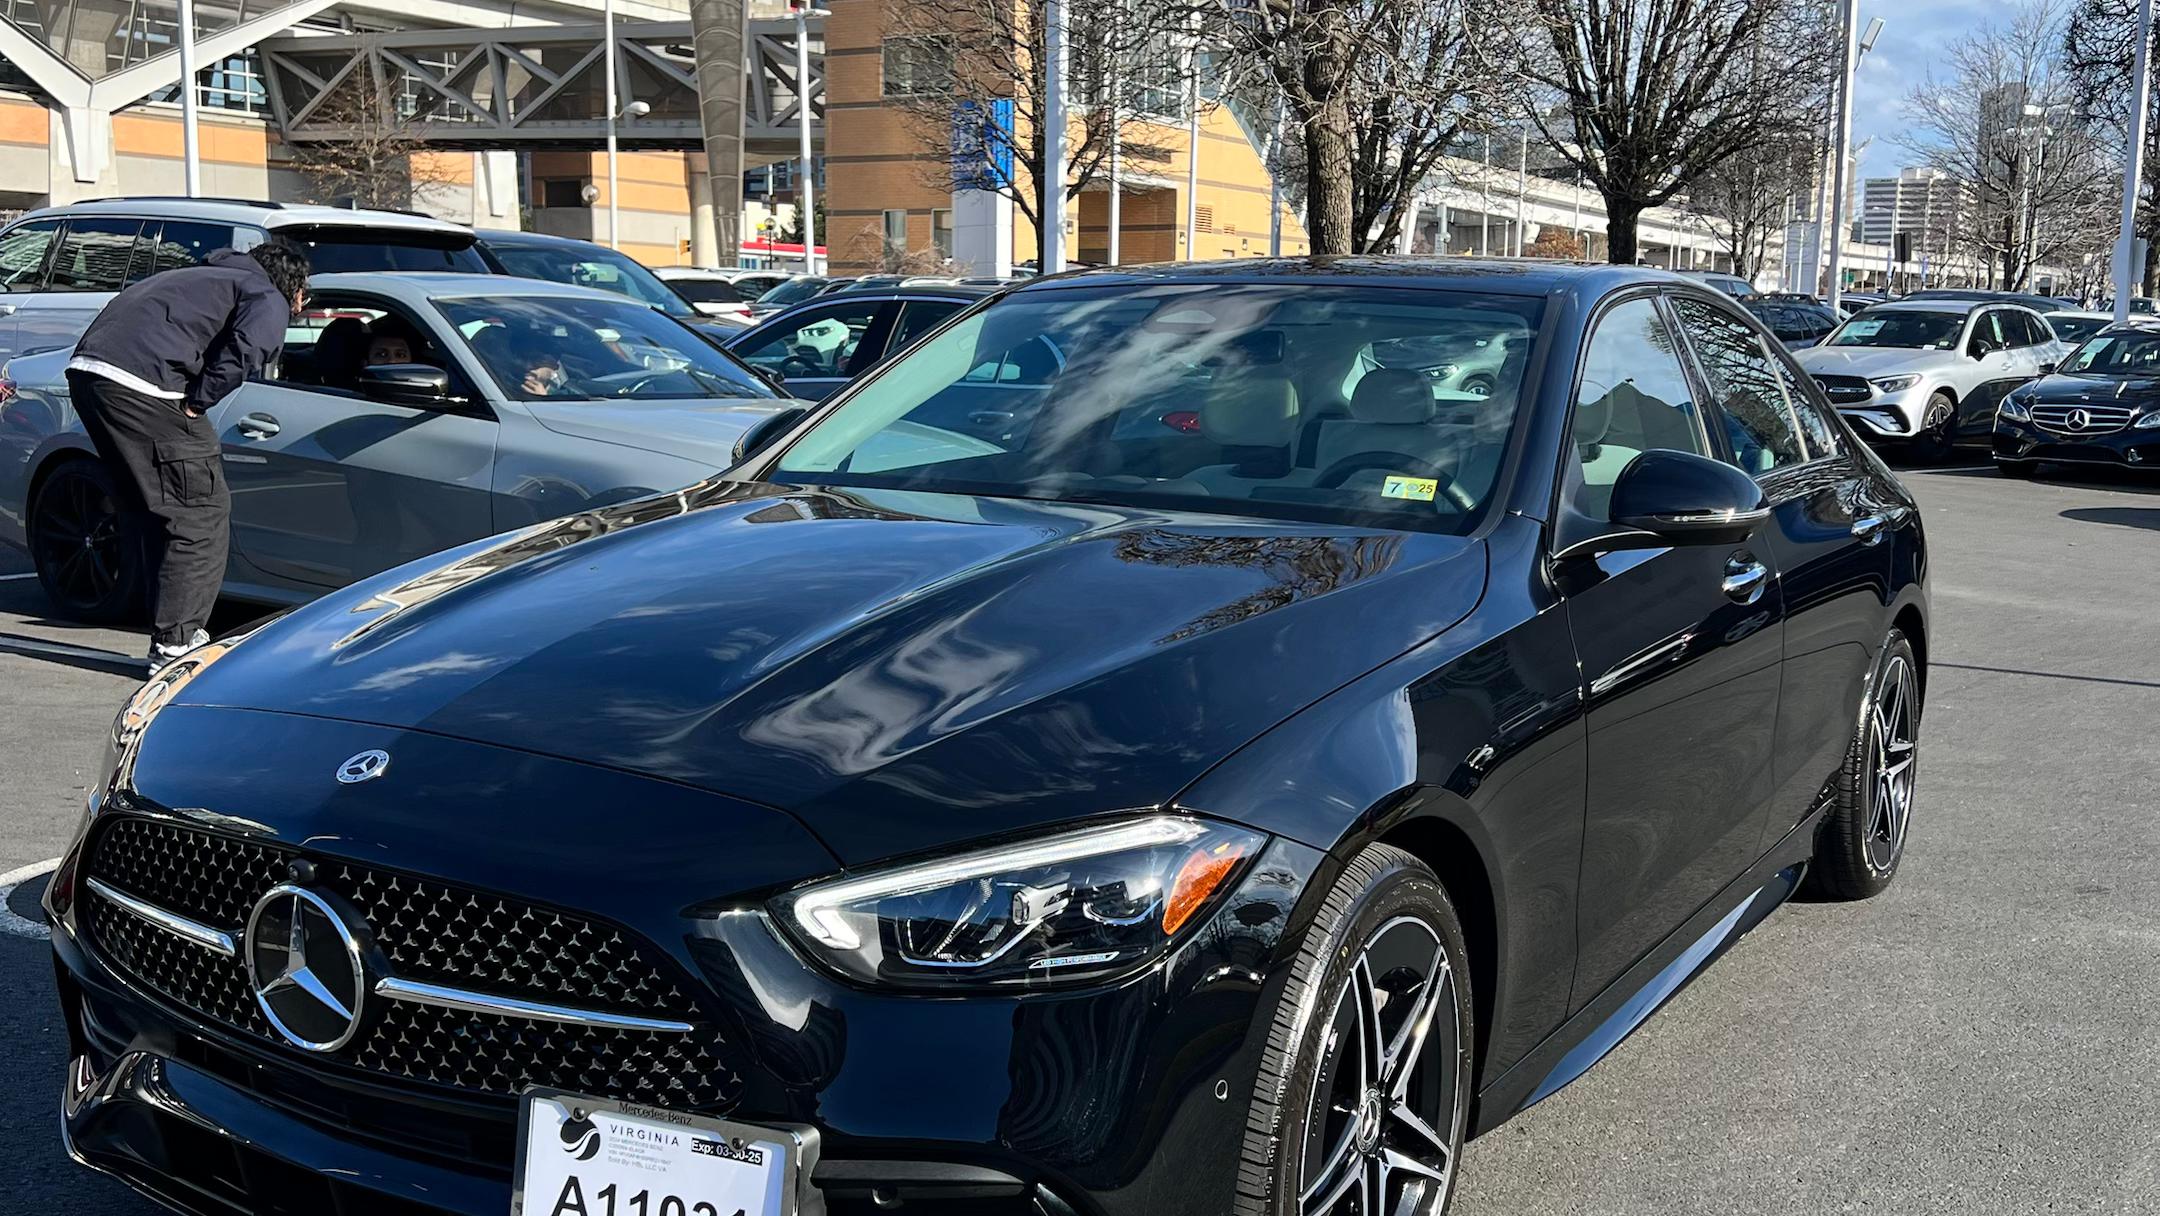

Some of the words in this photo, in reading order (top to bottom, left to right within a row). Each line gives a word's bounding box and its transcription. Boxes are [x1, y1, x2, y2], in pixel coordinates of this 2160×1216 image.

[1390, 482, 1401, 493] 7
[1418, 484, 1434, 494] 25
[618, 1102, 692, 1126] Mercedes-Benz
[610, 1124, 680, 1147] VIRGINIA
[692, 1140, 714, 1155] Exp:
[551, 1175, 746, 1216] A11
